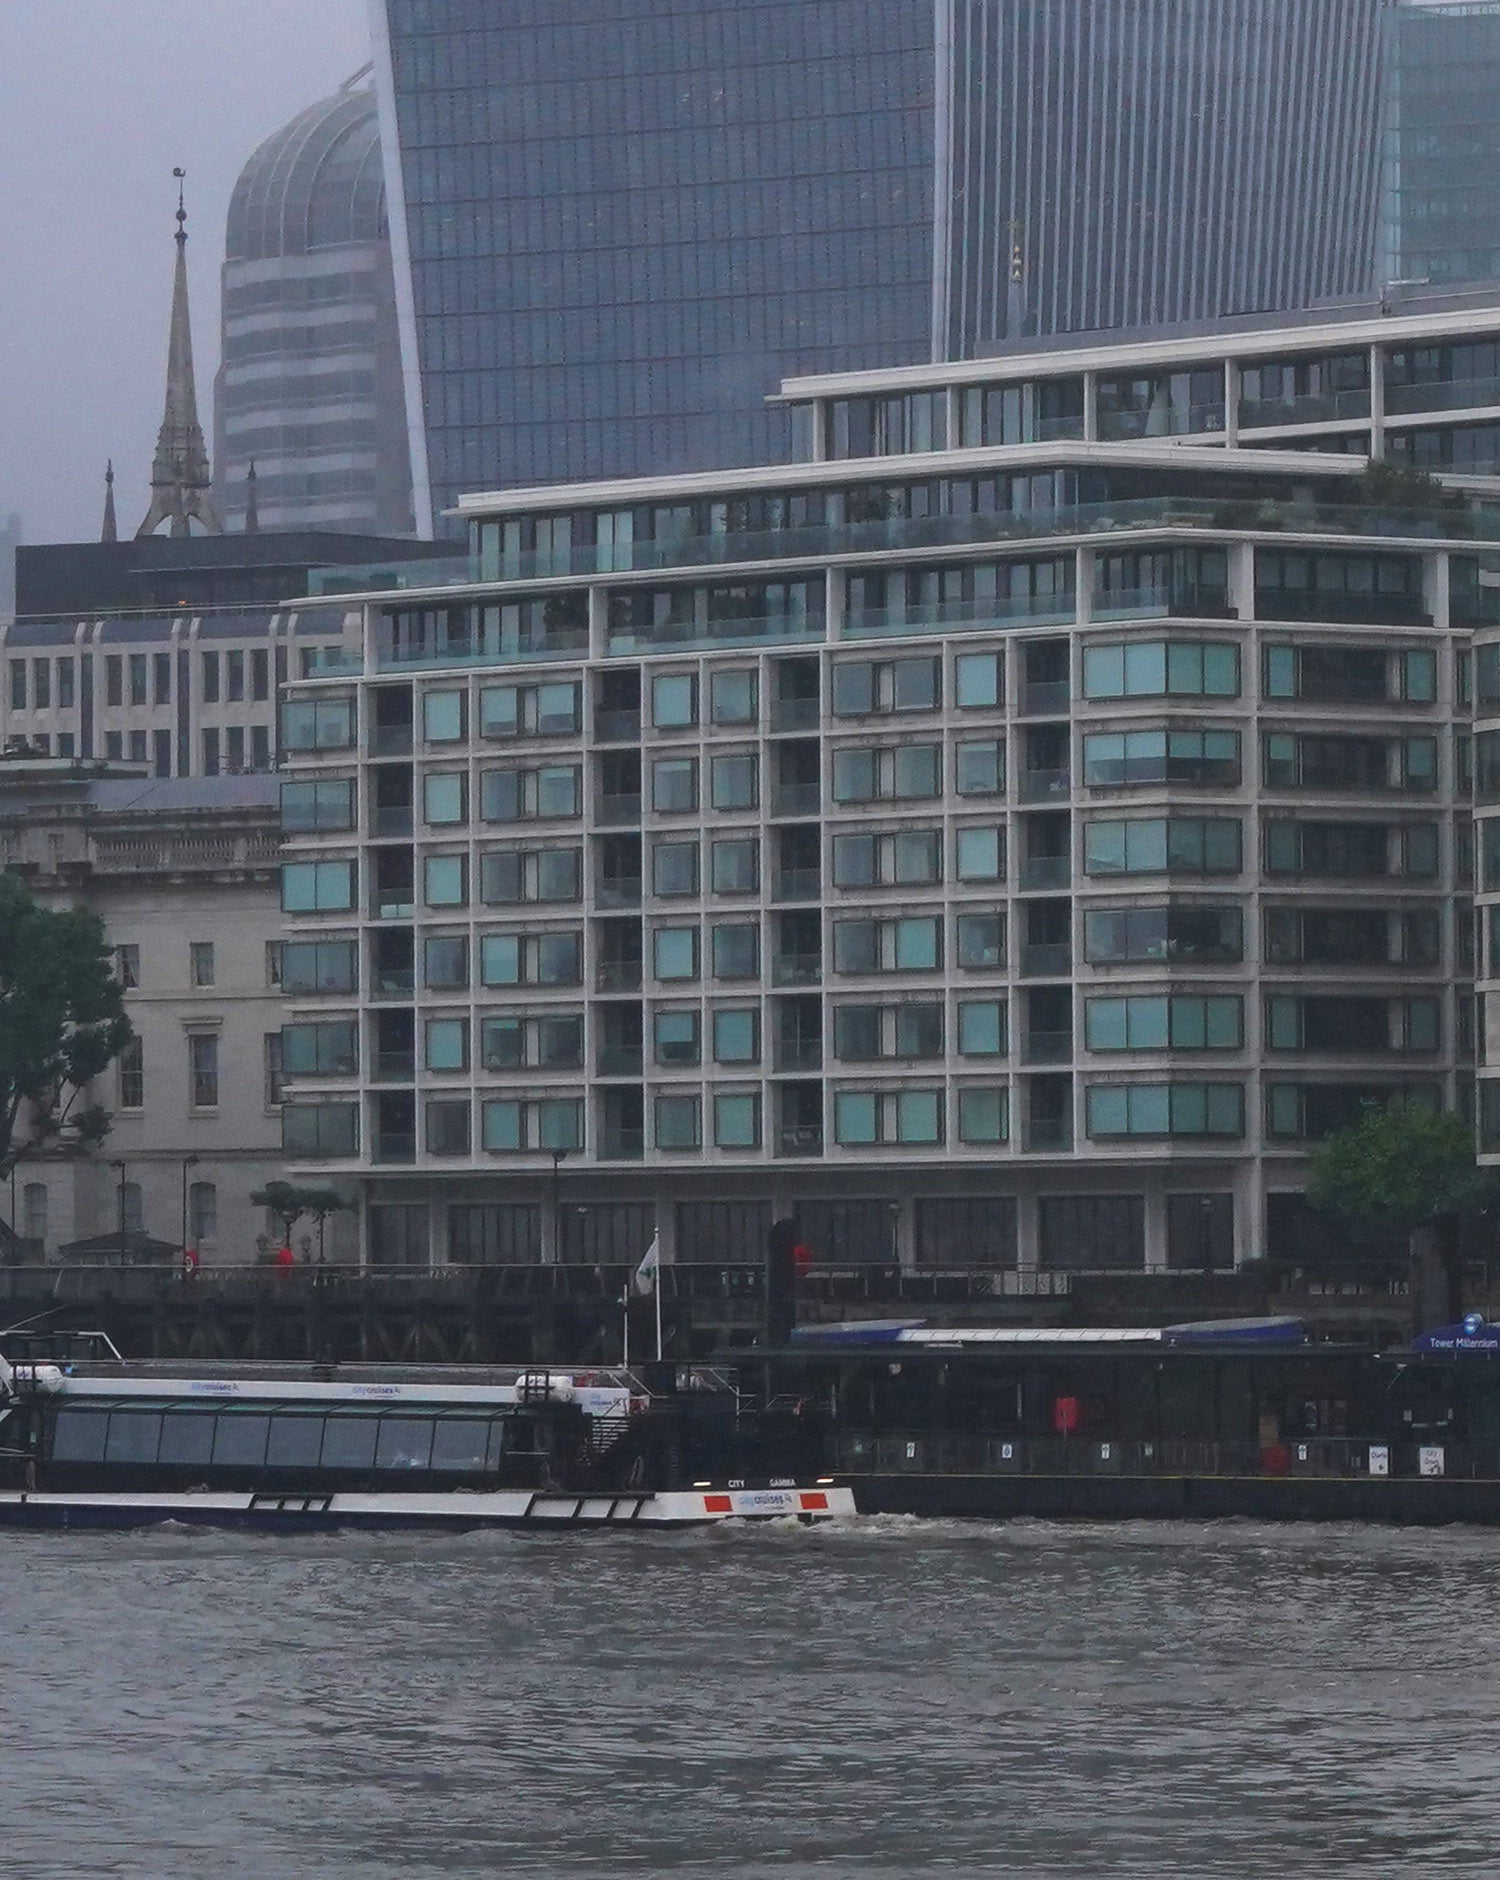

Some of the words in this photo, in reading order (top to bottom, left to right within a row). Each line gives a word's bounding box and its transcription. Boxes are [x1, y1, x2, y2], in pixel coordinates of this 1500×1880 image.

[1430, 1337, 1454, 1348] Tower
[1456, 1337, 1498, 1348] Millennium
[728, 1479, 745, 1488] CITY
